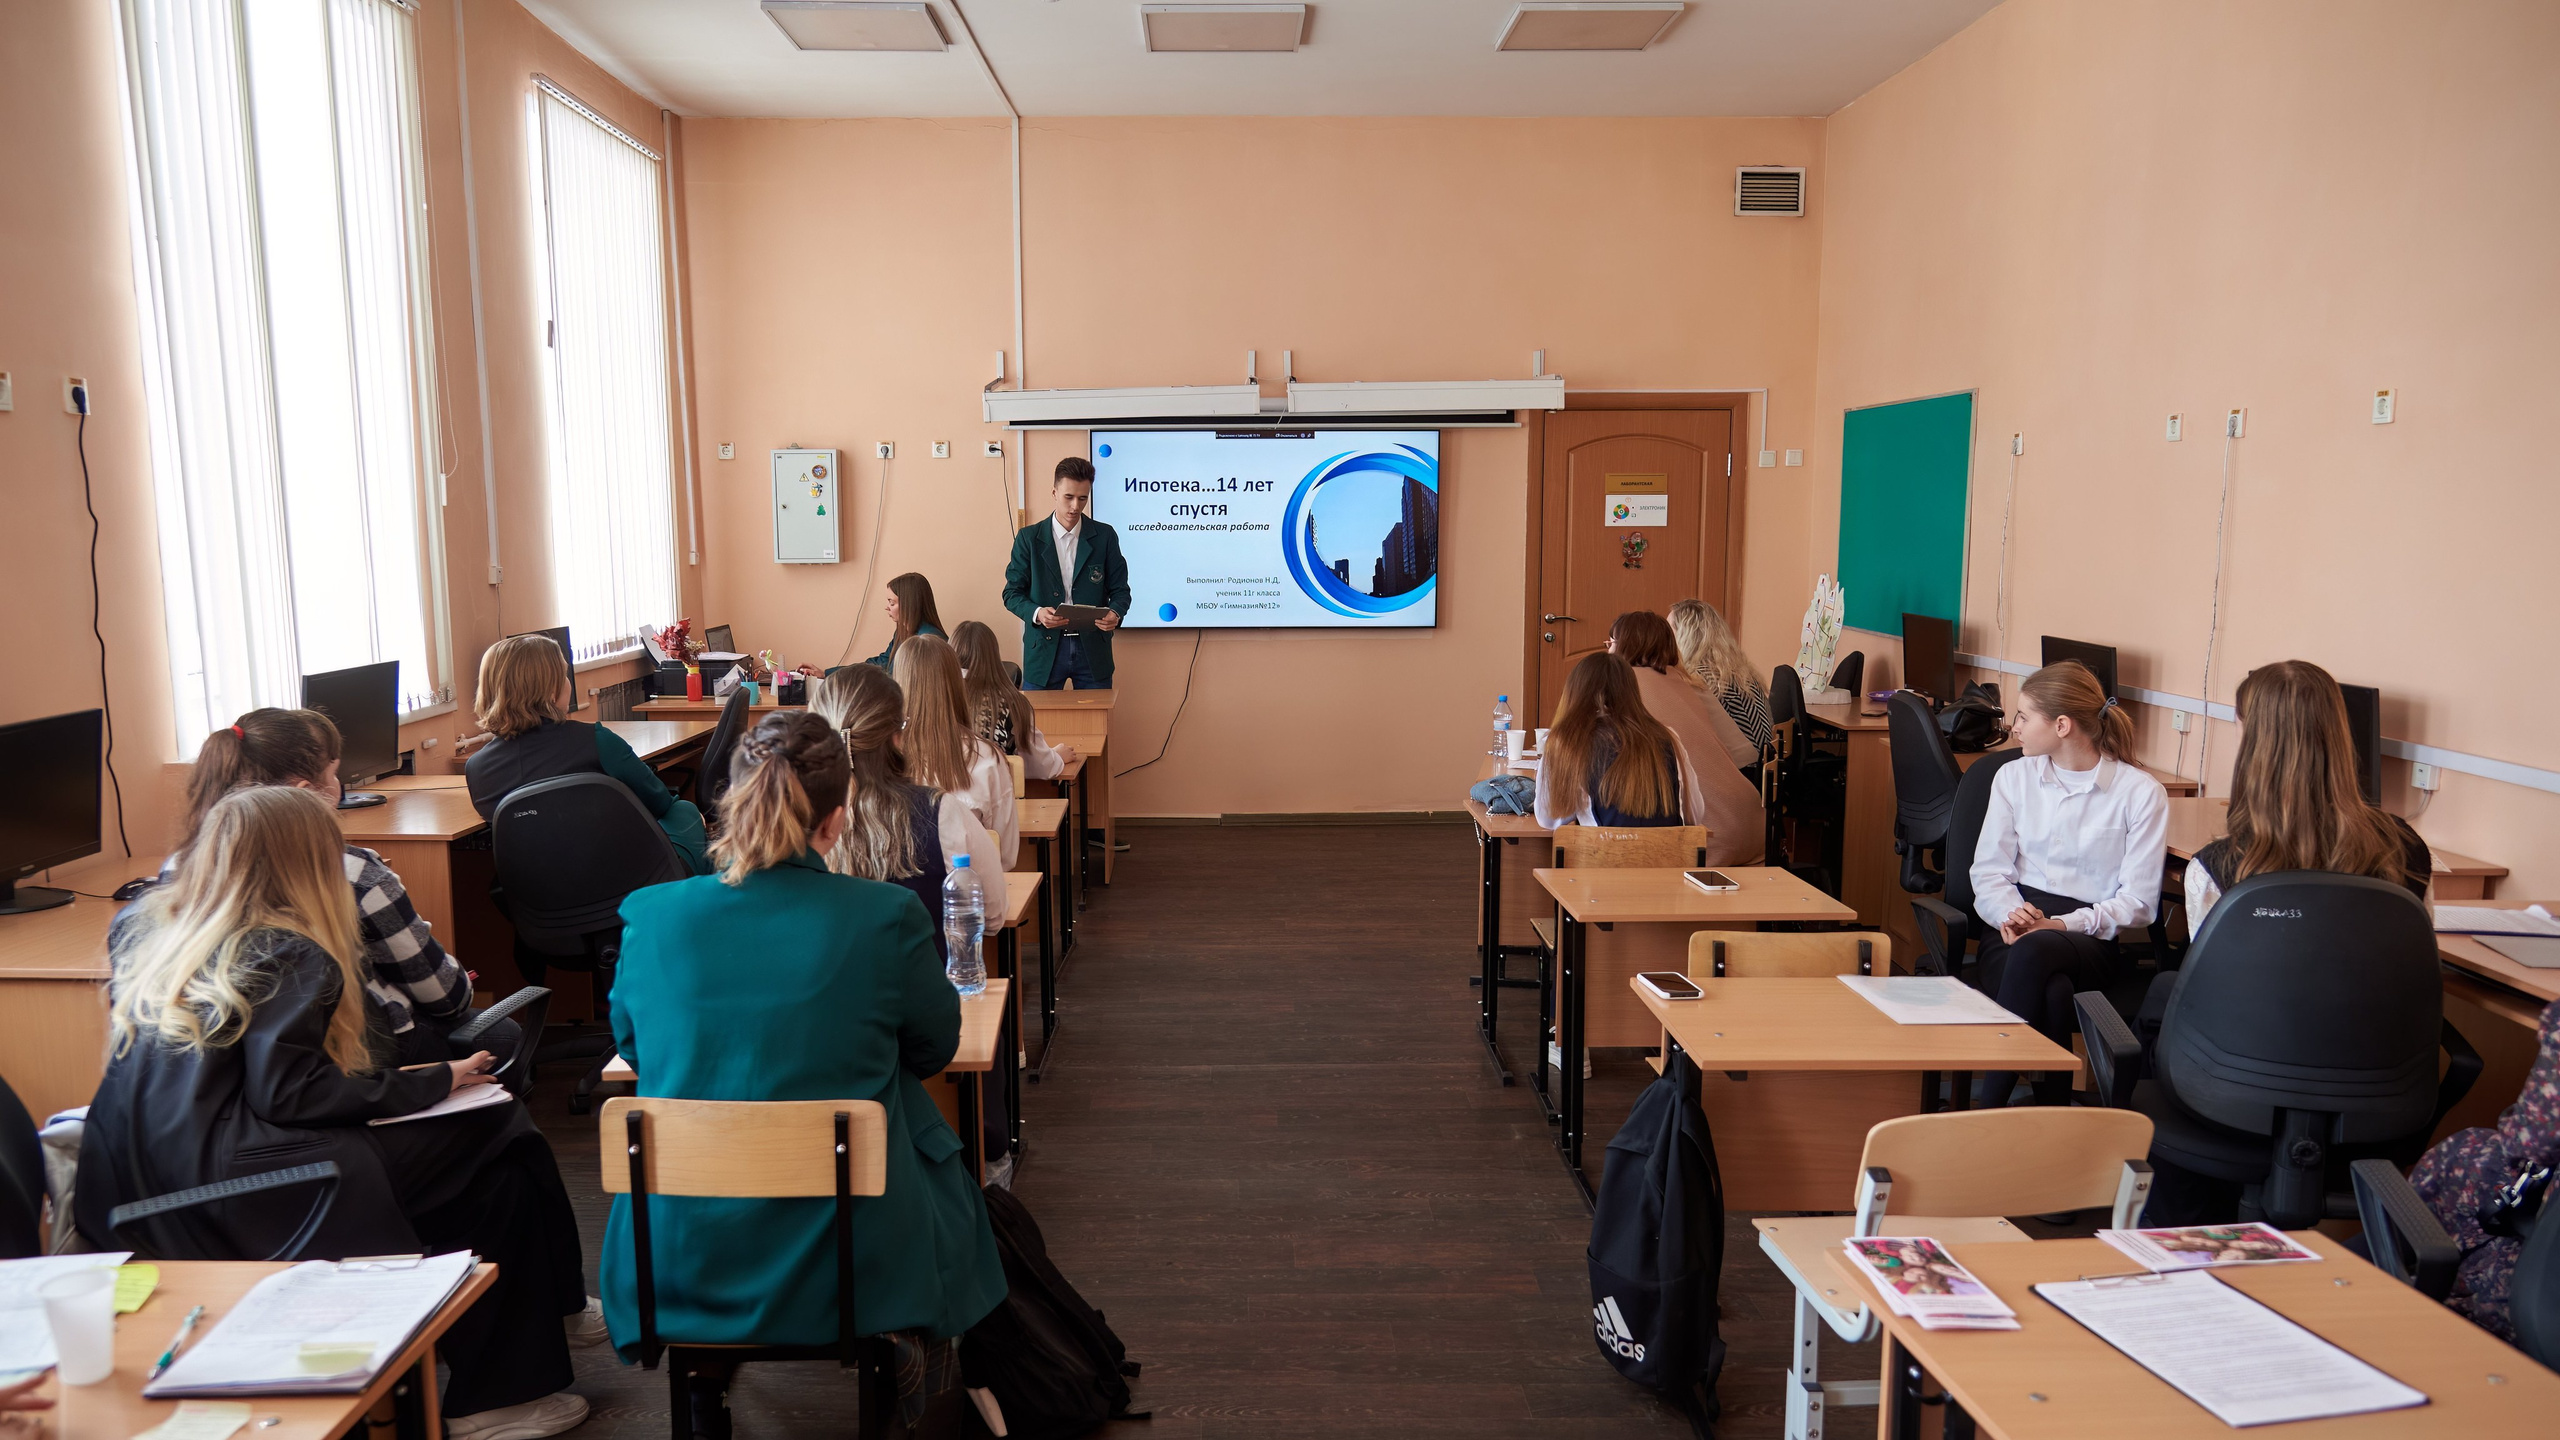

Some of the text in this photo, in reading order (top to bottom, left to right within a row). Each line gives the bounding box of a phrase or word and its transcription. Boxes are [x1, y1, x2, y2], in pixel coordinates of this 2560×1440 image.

[1243, 480, 1274, 493] лет
[1170, 504, 1228, 519] спустя
[1128, 521, 1270, 533] исследовательская работа
[1186, 576, 1226, 584] Выполнил:
[1227, 576, 1264, 585] Родионов
[1243, 589, 1255, 597] 11г
[1196, 602, 1281, 611] МБОУ «Гимназия№12»
[1596, 1321, 1646, 1363] didas
